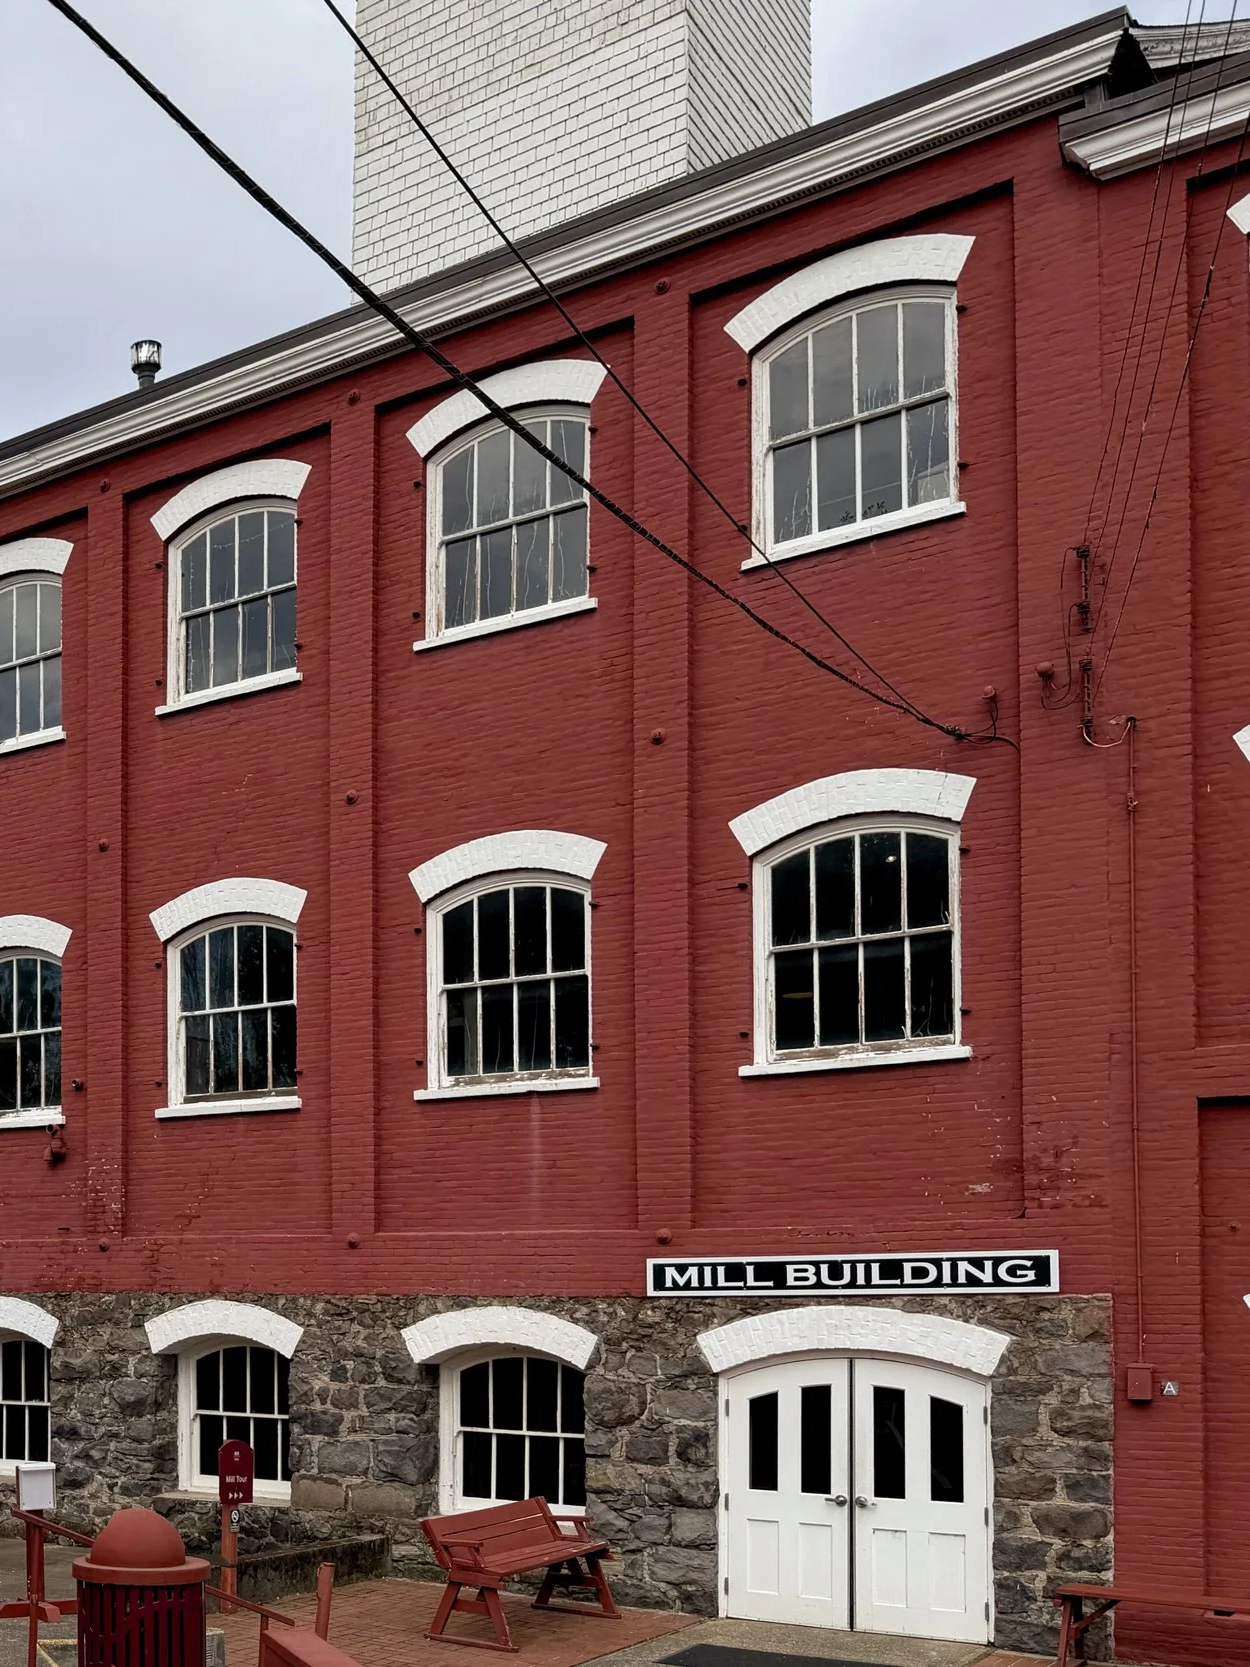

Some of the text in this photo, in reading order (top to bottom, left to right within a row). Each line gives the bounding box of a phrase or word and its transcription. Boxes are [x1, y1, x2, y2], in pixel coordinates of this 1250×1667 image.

[664, 1259, 1036, 1288] MILL BUILDING
[1163, 1381, 1176, 1395] A
